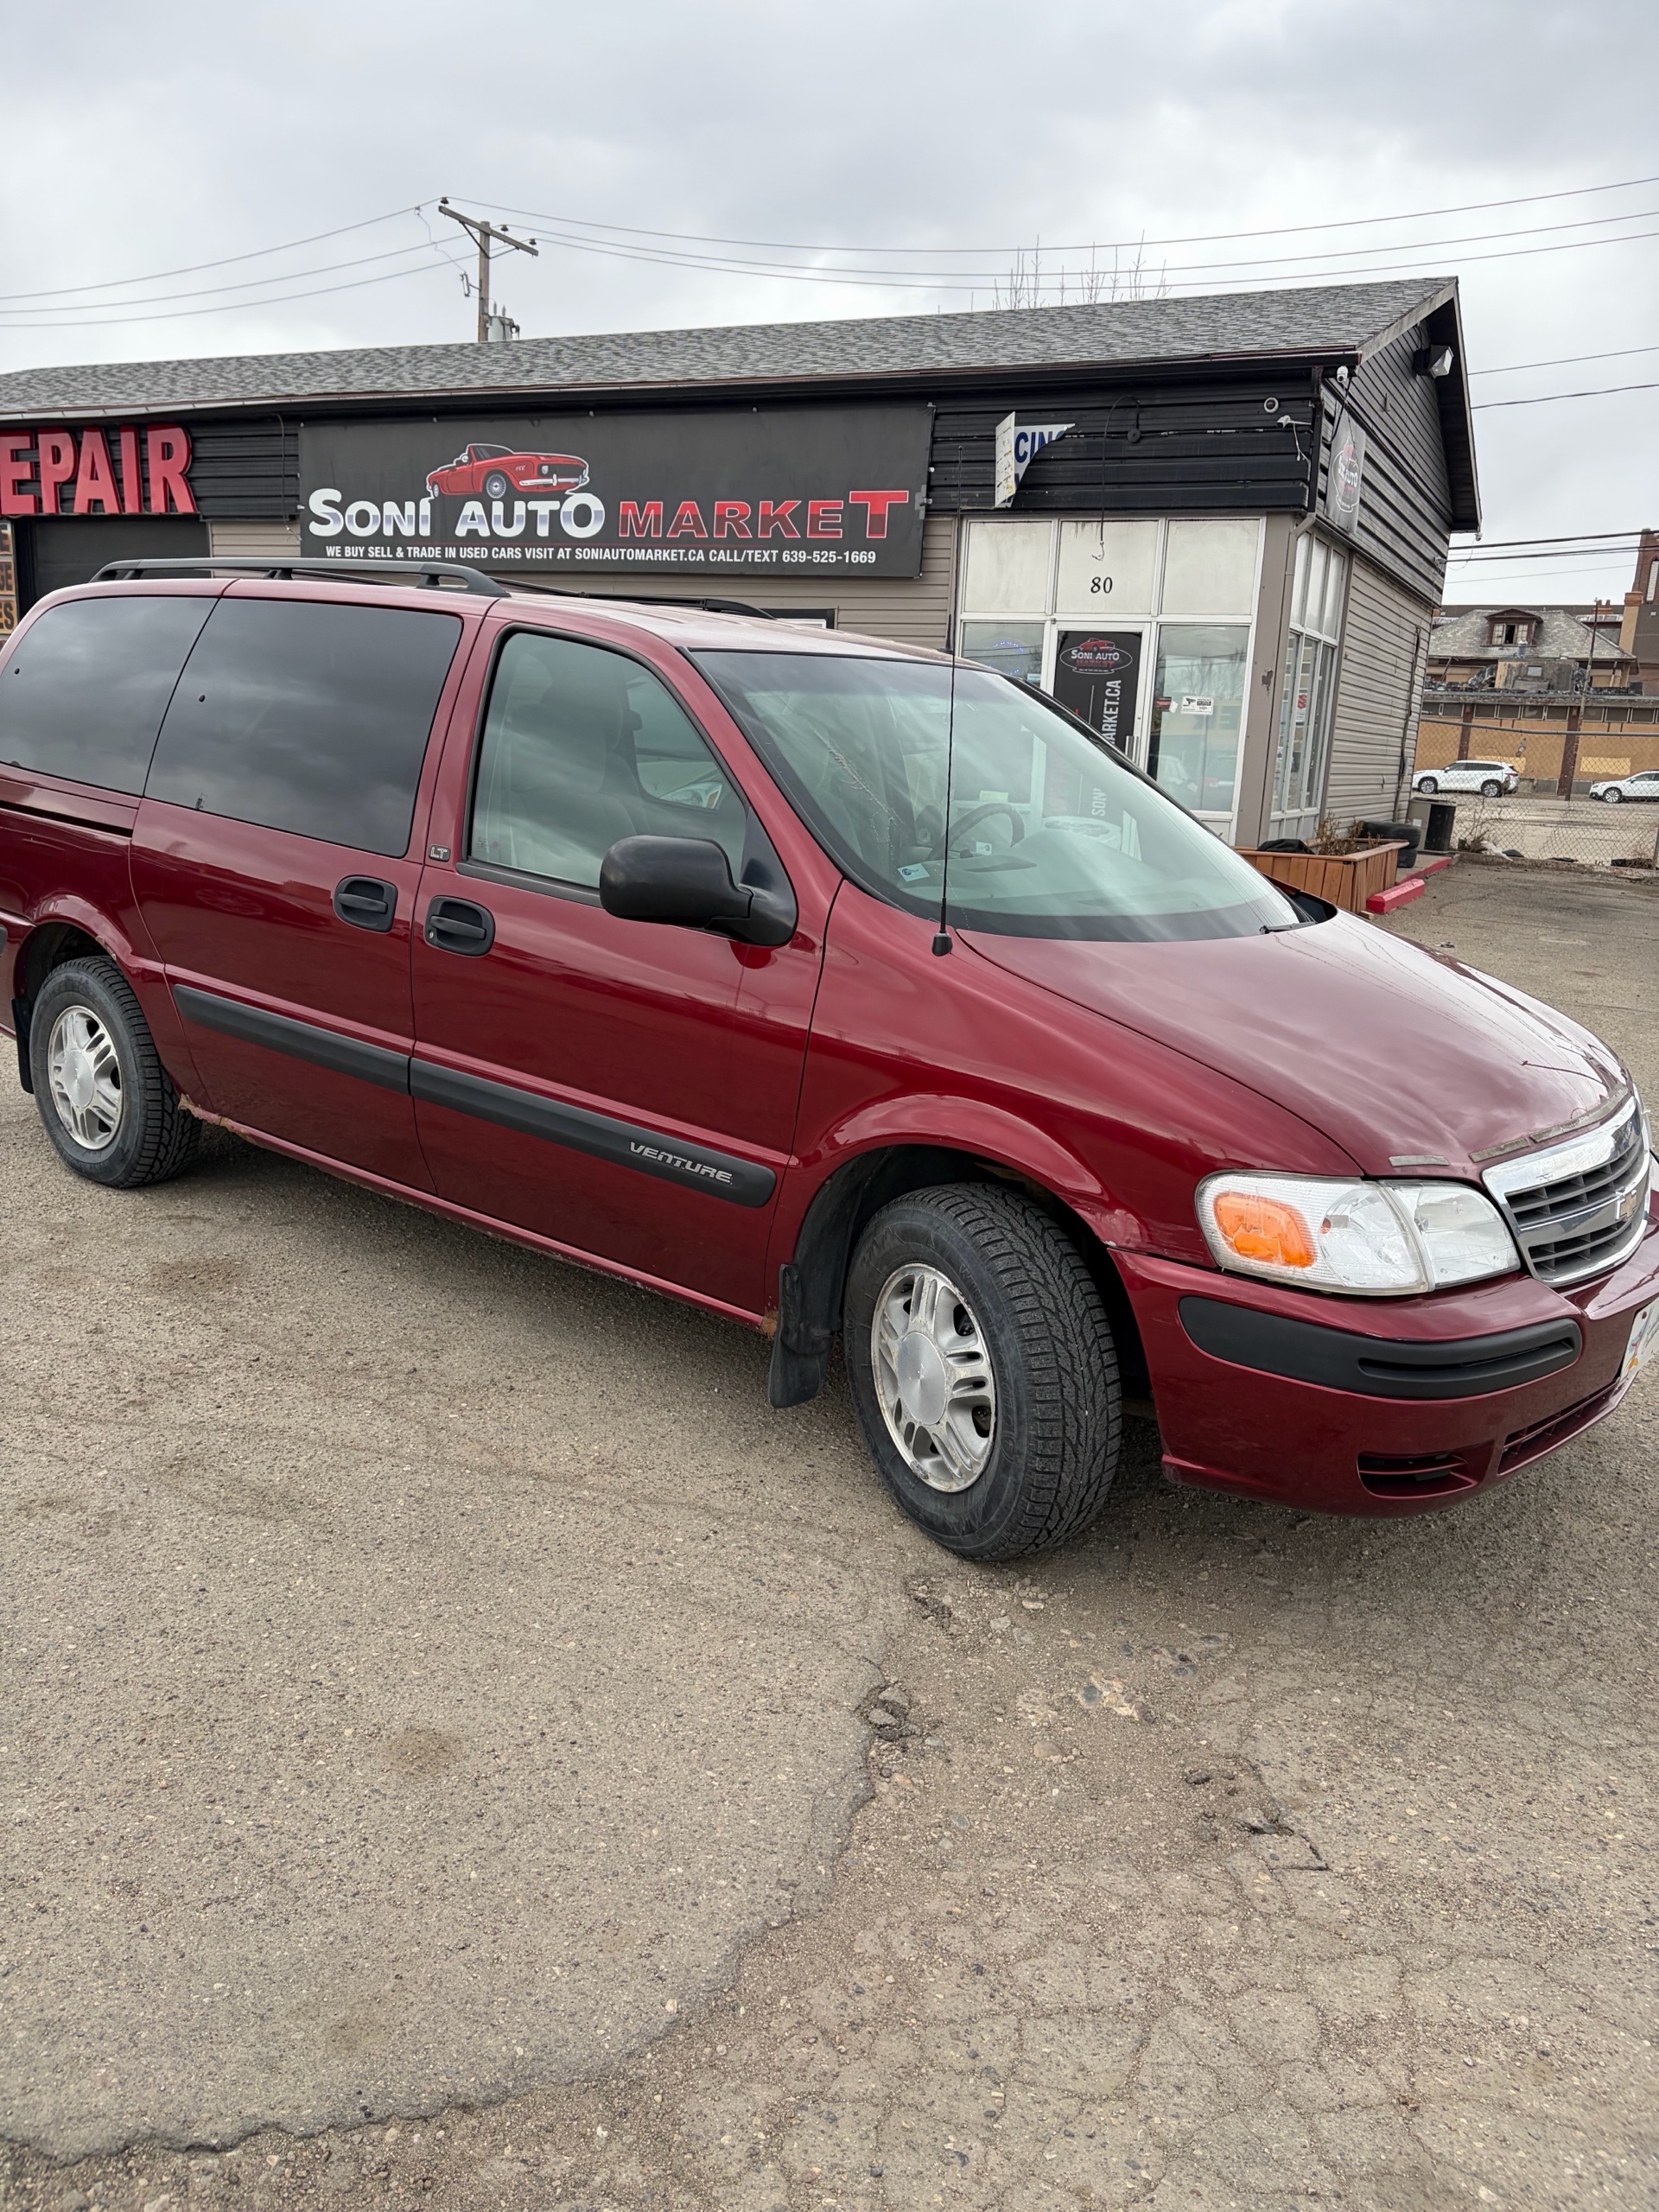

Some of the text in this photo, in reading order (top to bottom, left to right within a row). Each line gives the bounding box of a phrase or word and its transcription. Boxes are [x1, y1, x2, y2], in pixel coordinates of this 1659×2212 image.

[308, 487, 910, 539] SONI AUTO MARKET
[325, 545, 876, 564] WE BUY SELL & TRADE IN USED CARS VISIT AT SONIAUTOMARKET.CA CALL/TEXT 639-525-1669
[1090, 576, 1113, 594] 80
[1071, 649, 1120, 661] SONI AUTO
[1101, 680, 1122, 745] ARKET.CA
[430, 847, 448, 859] LT
[630, 1141, 733, 1185] VENTURE
